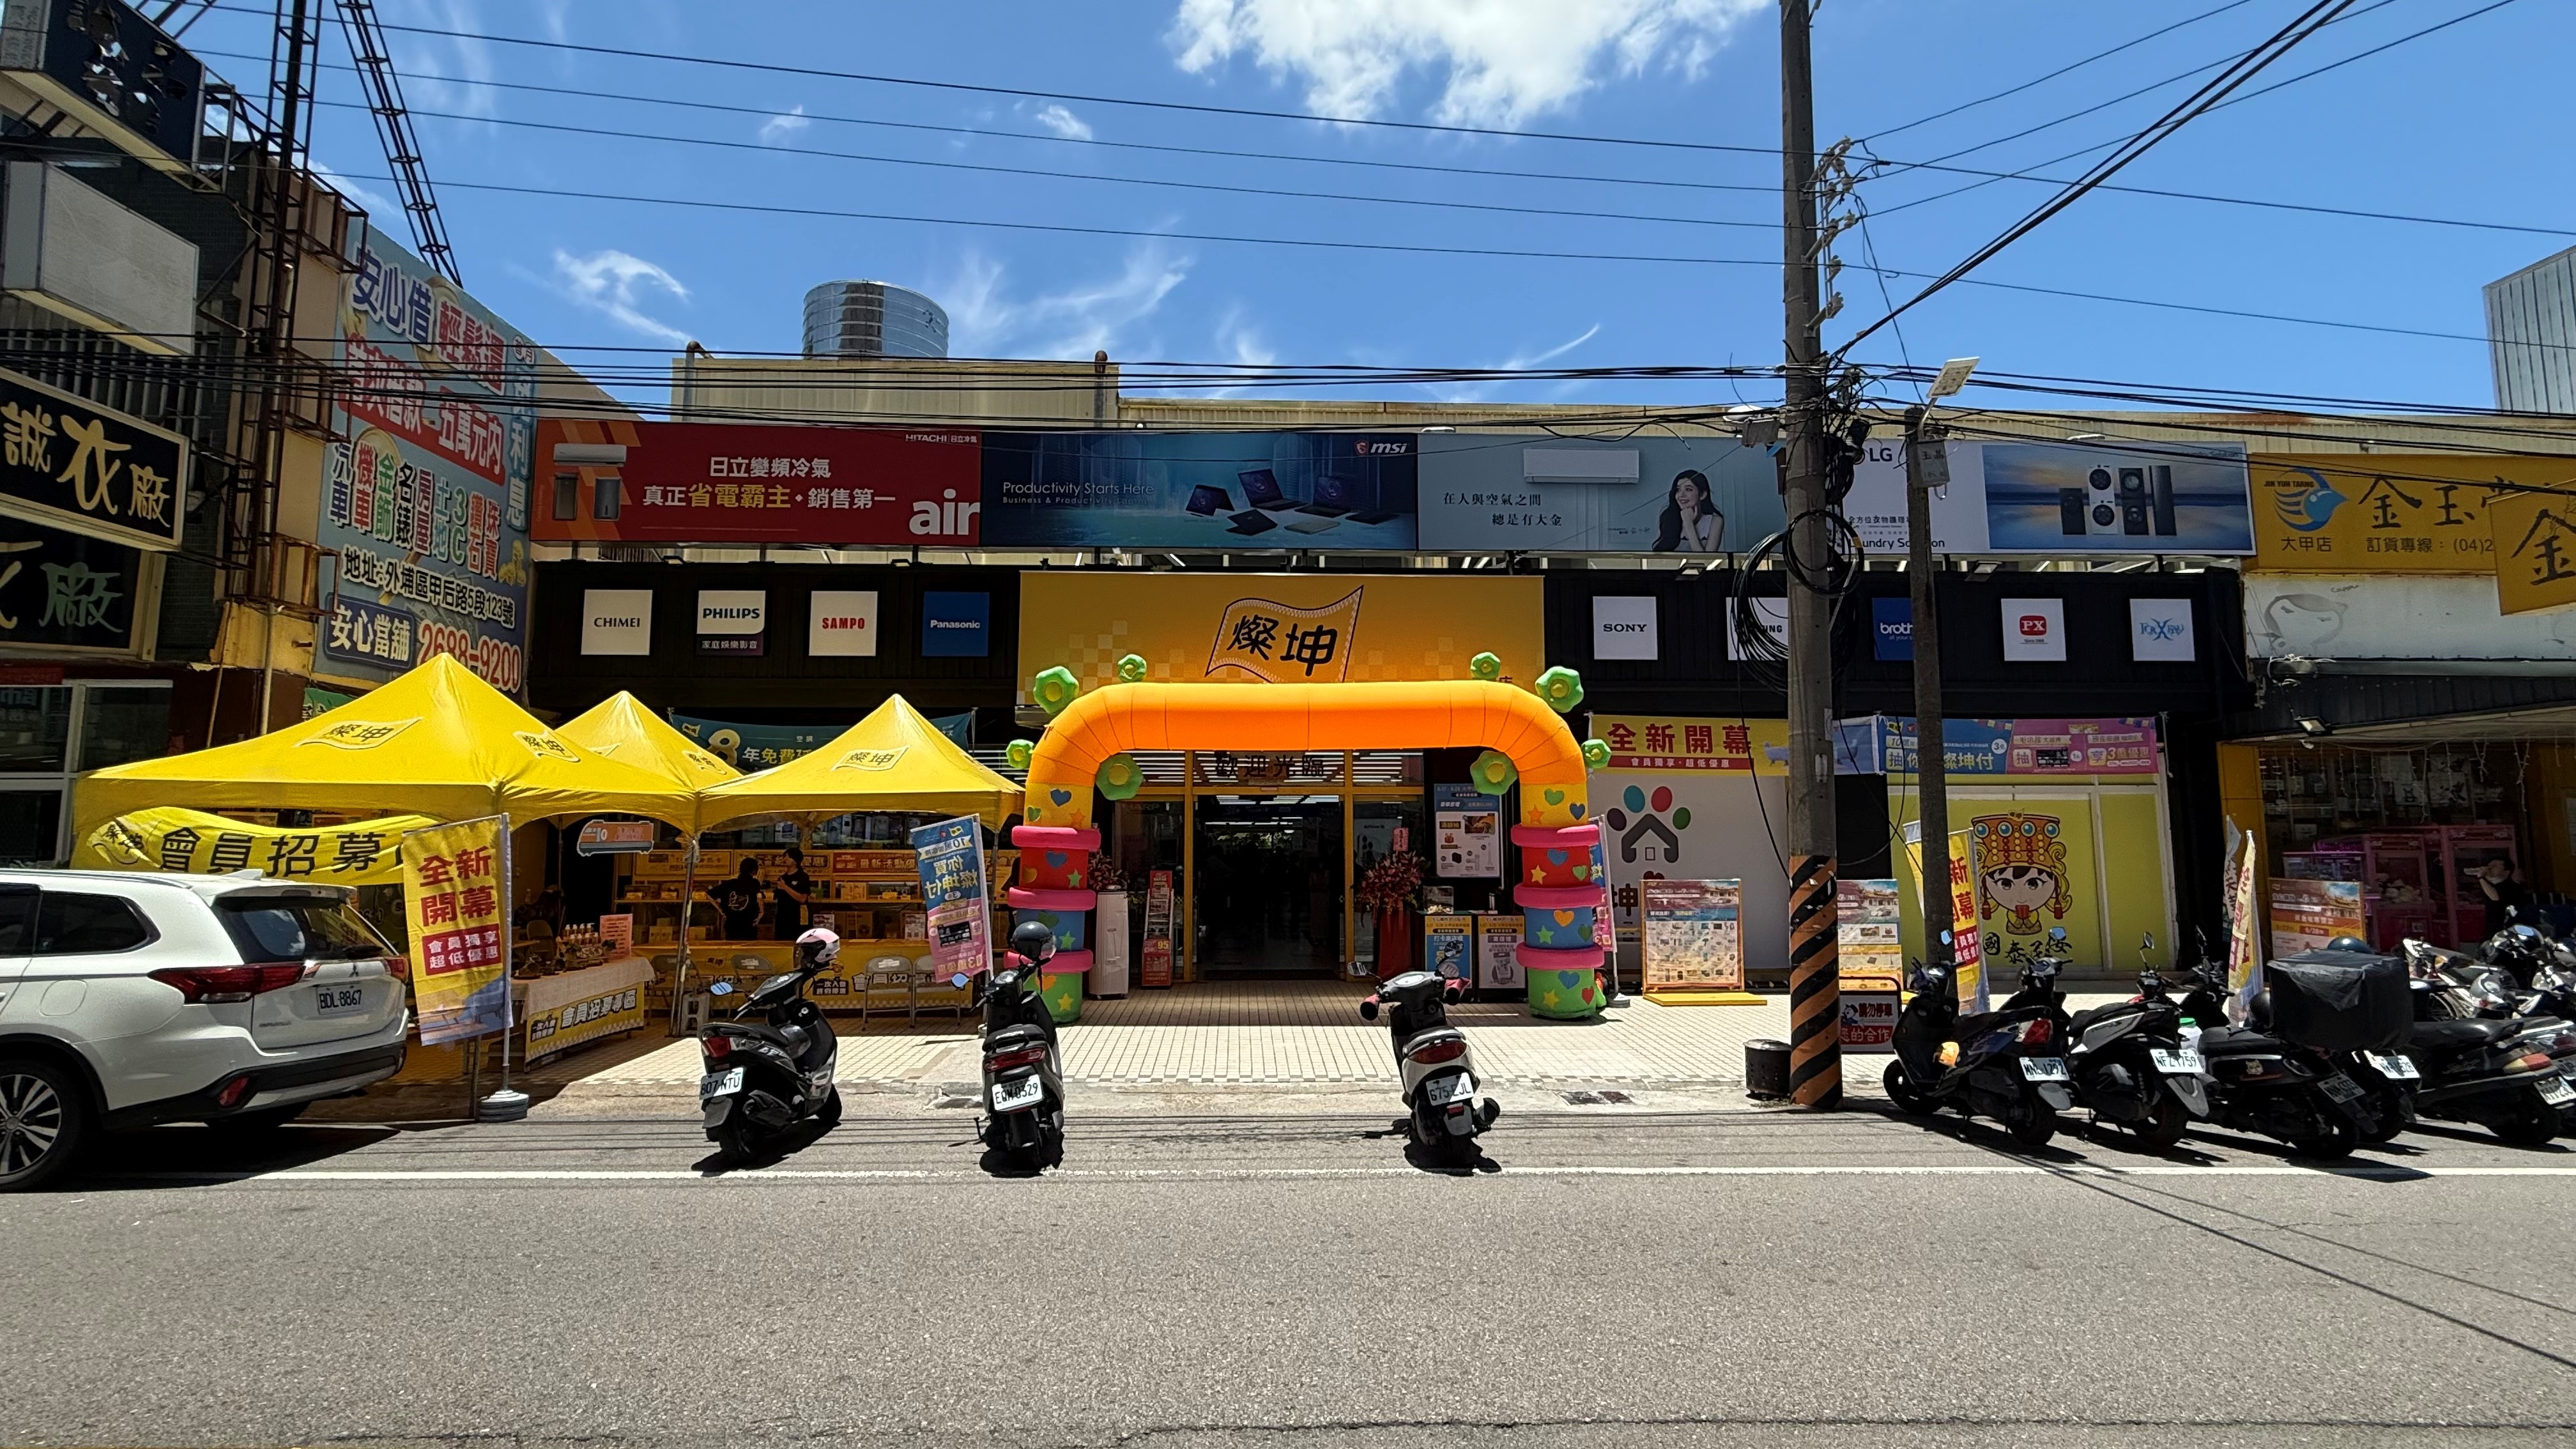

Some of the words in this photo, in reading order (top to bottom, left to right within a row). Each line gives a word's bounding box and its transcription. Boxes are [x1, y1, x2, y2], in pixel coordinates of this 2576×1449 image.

[352, 245, 433, 346] 安心借
[439, 397, 503, 475] 五萬元內
[905, 434, 947, 443] HITACHI
[951, 434, 977, 443] 日立冷氣
[1370, 441, 1408, 454] msi
[1869, 447, 1892, 462] LG
[709, 456, 832, 479] 日立變頻冷氣
[329, 443, 352, 526] 汽車
[353, 443, 376, 532] 機車
[1003, 482, 1081, 496] Productivity
[1084, 482, 1119, 494] Starts
[1123, 483, 1154, 494] Here
[374, 453, 395, 540] 金飾
[1055, 497, 1113, 505] Productivity
[1443, 492, 1541, 506] 在人與空氣之間
[417, 468, 435, 554] 房屋
[433, 479, 451, 560] 土地
[908, 489, 980, 536] air
[1492, 513, 1563, 526] 總是有大金
[1849, 514, 1909, 524] 全方位衣物護理
[484, 499, 500, 579] 珠寶
[2281, 537, 2332, 553] 大甲店
[594, 617, 641, 628] CHIMEI
[702, 608, 760, 619] PHILIPS
[822, 617, 866, 630] SAMPO
[930, 619, 981, 629] Panasonic
[1602, 622, 1648, 633] SONY
[2021, 620, 2045, 631] PX
[418, 622, 521, 690] 2688-9200
[1226, 614, 1338, 677] 燦坤
[330, 723, 394, 742] 燦坤
[1607, 723, 1751, 755] 全新開幕
[844, 750, 896, 765] 燦坤
[1215, 754, 1325, 778] 歡迎光臨
[162, 827, 404, 878] 會員招募
[417, 845, 491, 887] 全新
[420, 884, 496, 927] 開幕
[427, 930, 497, 953] 會員獨享
[429, 946, 499, 969] 超低優惠
[319, 989, 362, 1009] BDL-8867
[1859, 1002, 1893, 1018] 請勿停車
